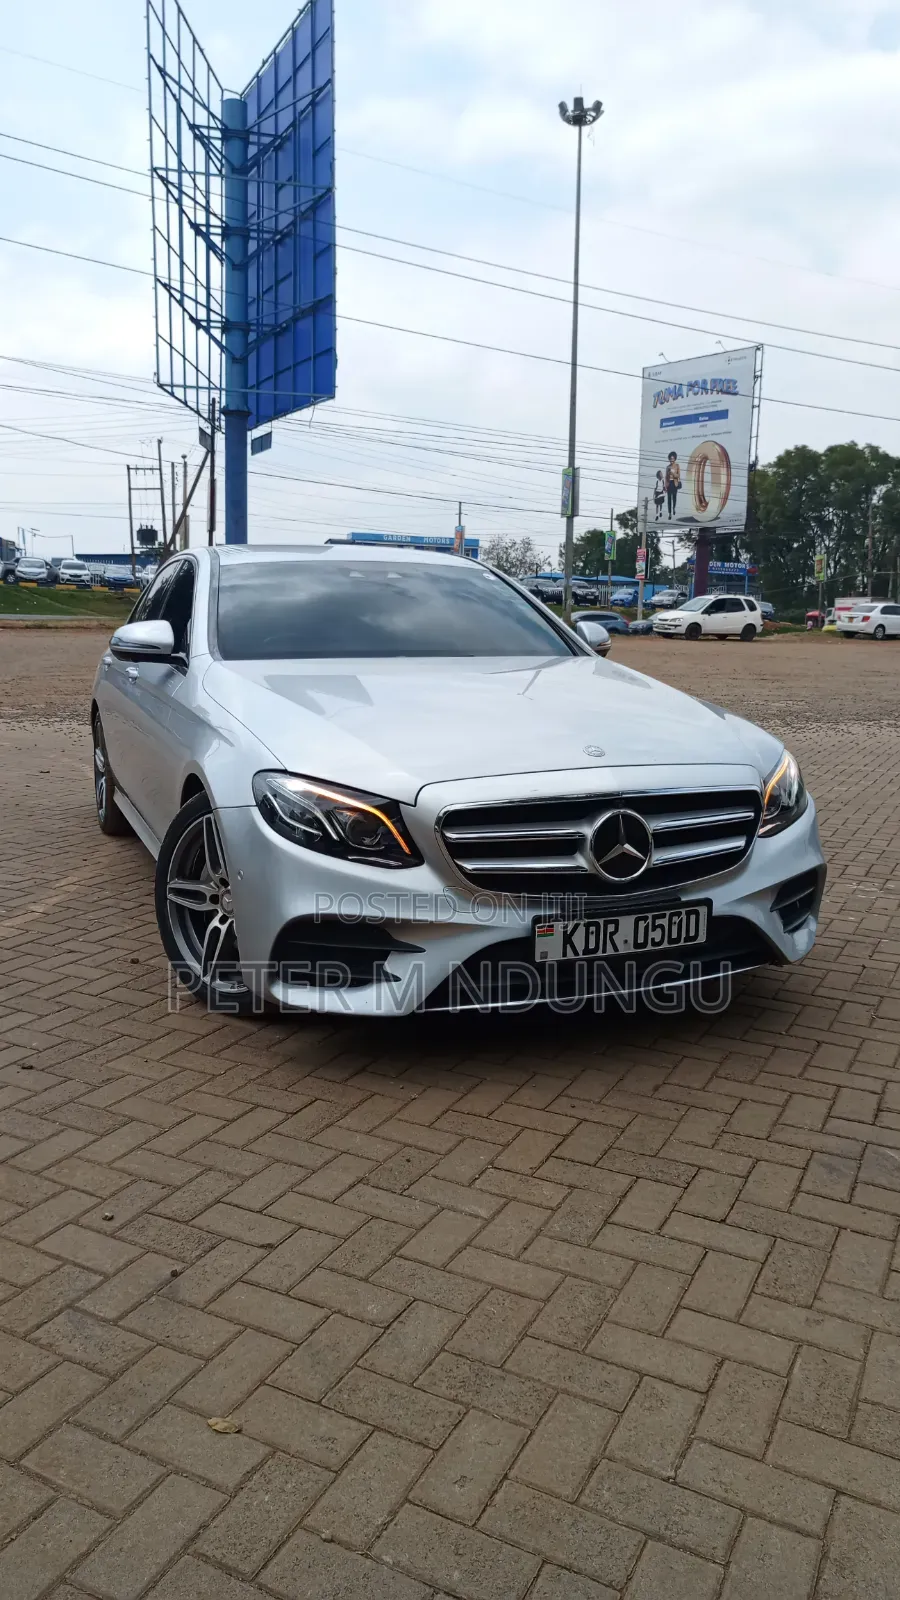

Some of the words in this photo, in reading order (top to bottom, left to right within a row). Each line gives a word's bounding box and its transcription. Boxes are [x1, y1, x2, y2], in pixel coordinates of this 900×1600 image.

[652, 383, 684, 409] TUMA
[686, 378, 710, 398] FOR
[709, 377, 740, 397] FREE
[383, 534, 411, 543] GARDEN
[423, 537, 450, 545] MOTORS
[724, 562, 749, 570] MOTORS
[561, 918, 620, 958] KDR
[632, 908, 701, 950] 050D
